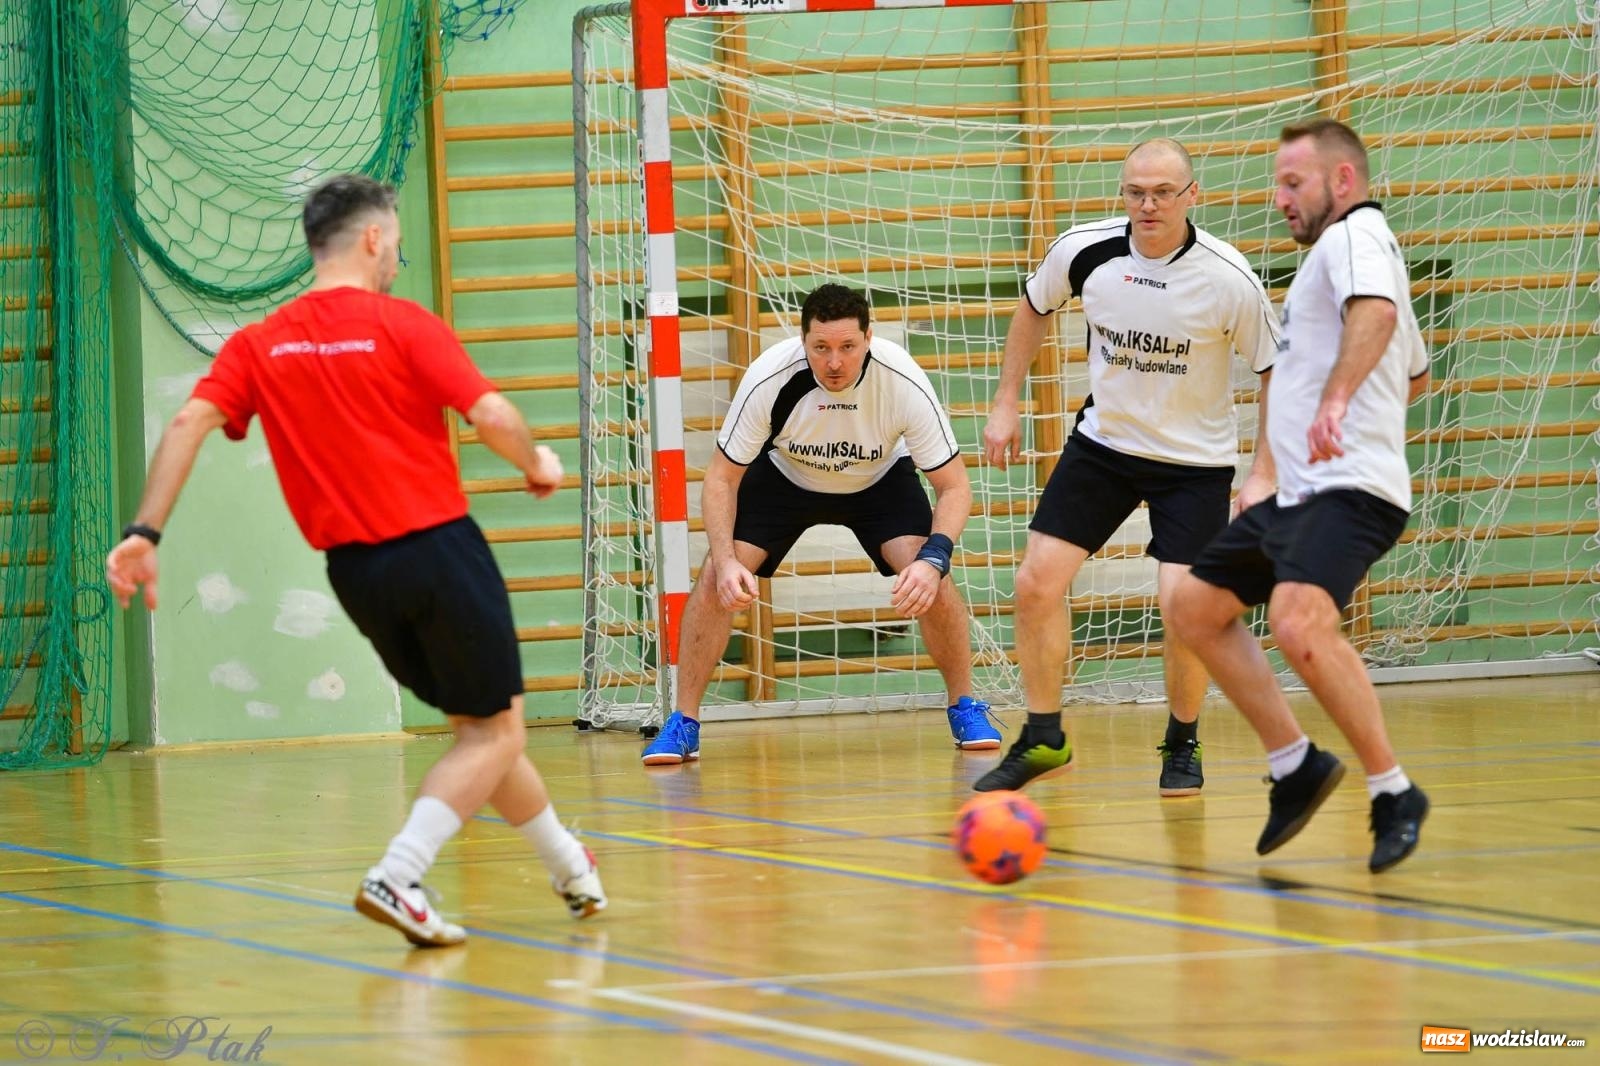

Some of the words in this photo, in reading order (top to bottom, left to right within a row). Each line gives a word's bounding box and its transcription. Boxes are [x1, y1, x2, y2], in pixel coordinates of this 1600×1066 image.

[1133, 277, 1167, 290] PATRICK
[1134, 357, 1187, 375] budowlane
[788, 441, 882, 462] www.IKSAL.pl
